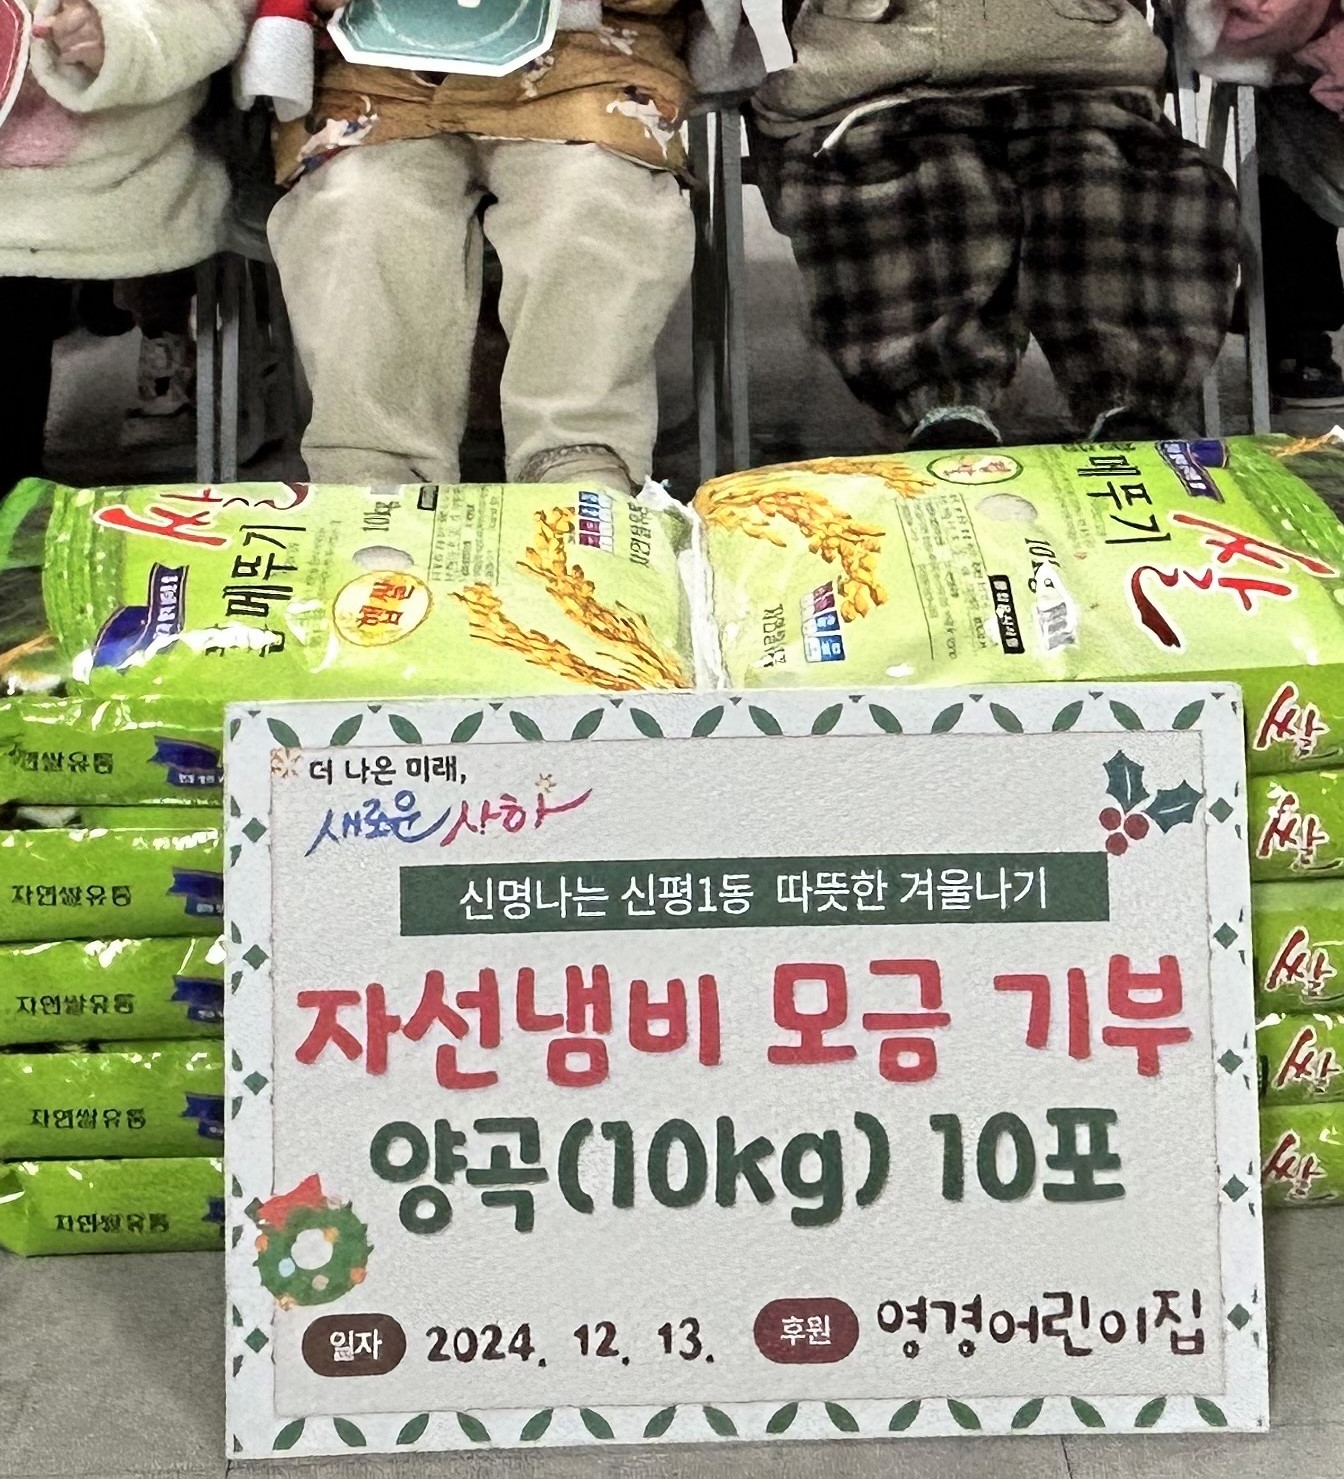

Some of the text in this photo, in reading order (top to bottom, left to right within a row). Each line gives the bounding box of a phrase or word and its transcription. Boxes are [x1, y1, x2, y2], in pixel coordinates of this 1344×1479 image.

[361, 500, 402, 534] 10kg
[1076, 454, 1172, 545] 메뚜기
[222, 524, 307, 618] 메뚜기
[1131, 513, 1337, 649] 쌀
[309, 755, 468, 785] 더 나은 미래,
[304, 786, 594, 858] 새로운 사하
[459, 865, 1048, 922] 신명나는 신평1동 따뜻한 겨울나기
[295, 954, 1191, 1090] 자선냄비 모금 기부
[368, 1106, 1125, 1234] 양곡(10kg) 10포
[329, 1317, 714, 1368] 일자 2024. 12. 13.
[779, 1287, 1205, 1360] 후원 영경어린이집
